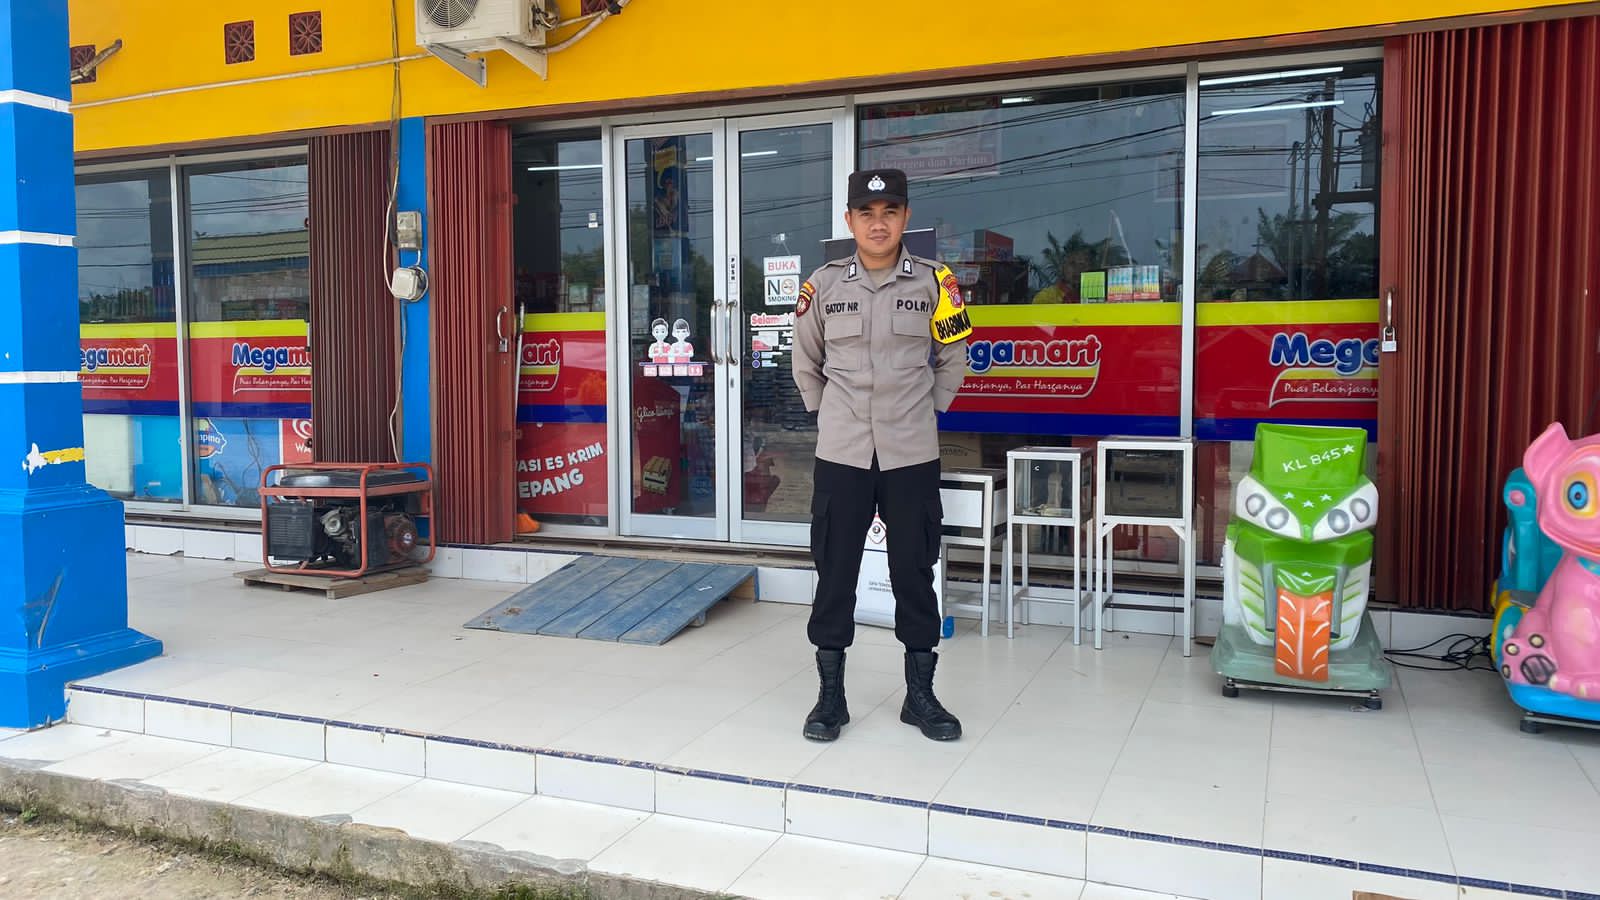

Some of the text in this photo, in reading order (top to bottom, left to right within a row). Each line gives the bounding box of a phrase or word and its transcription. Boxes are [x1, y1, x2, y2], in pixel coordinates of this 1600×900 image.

[768, 261, 797, 271] BUKA
[825, 302, 859, 315] GATOT NR
[896, 300, 929, 312] POLRI
[966, 334, 1101, 373] gamart
[1015, 380, 1031, 389] Pas
[1284, 382, 1308, 392] Puas
[516, 442, 604, 472] ASI ES KRIM
[1283, 448, 1341, 473] KL 845
[518, 468, 584, 498] EPANG
